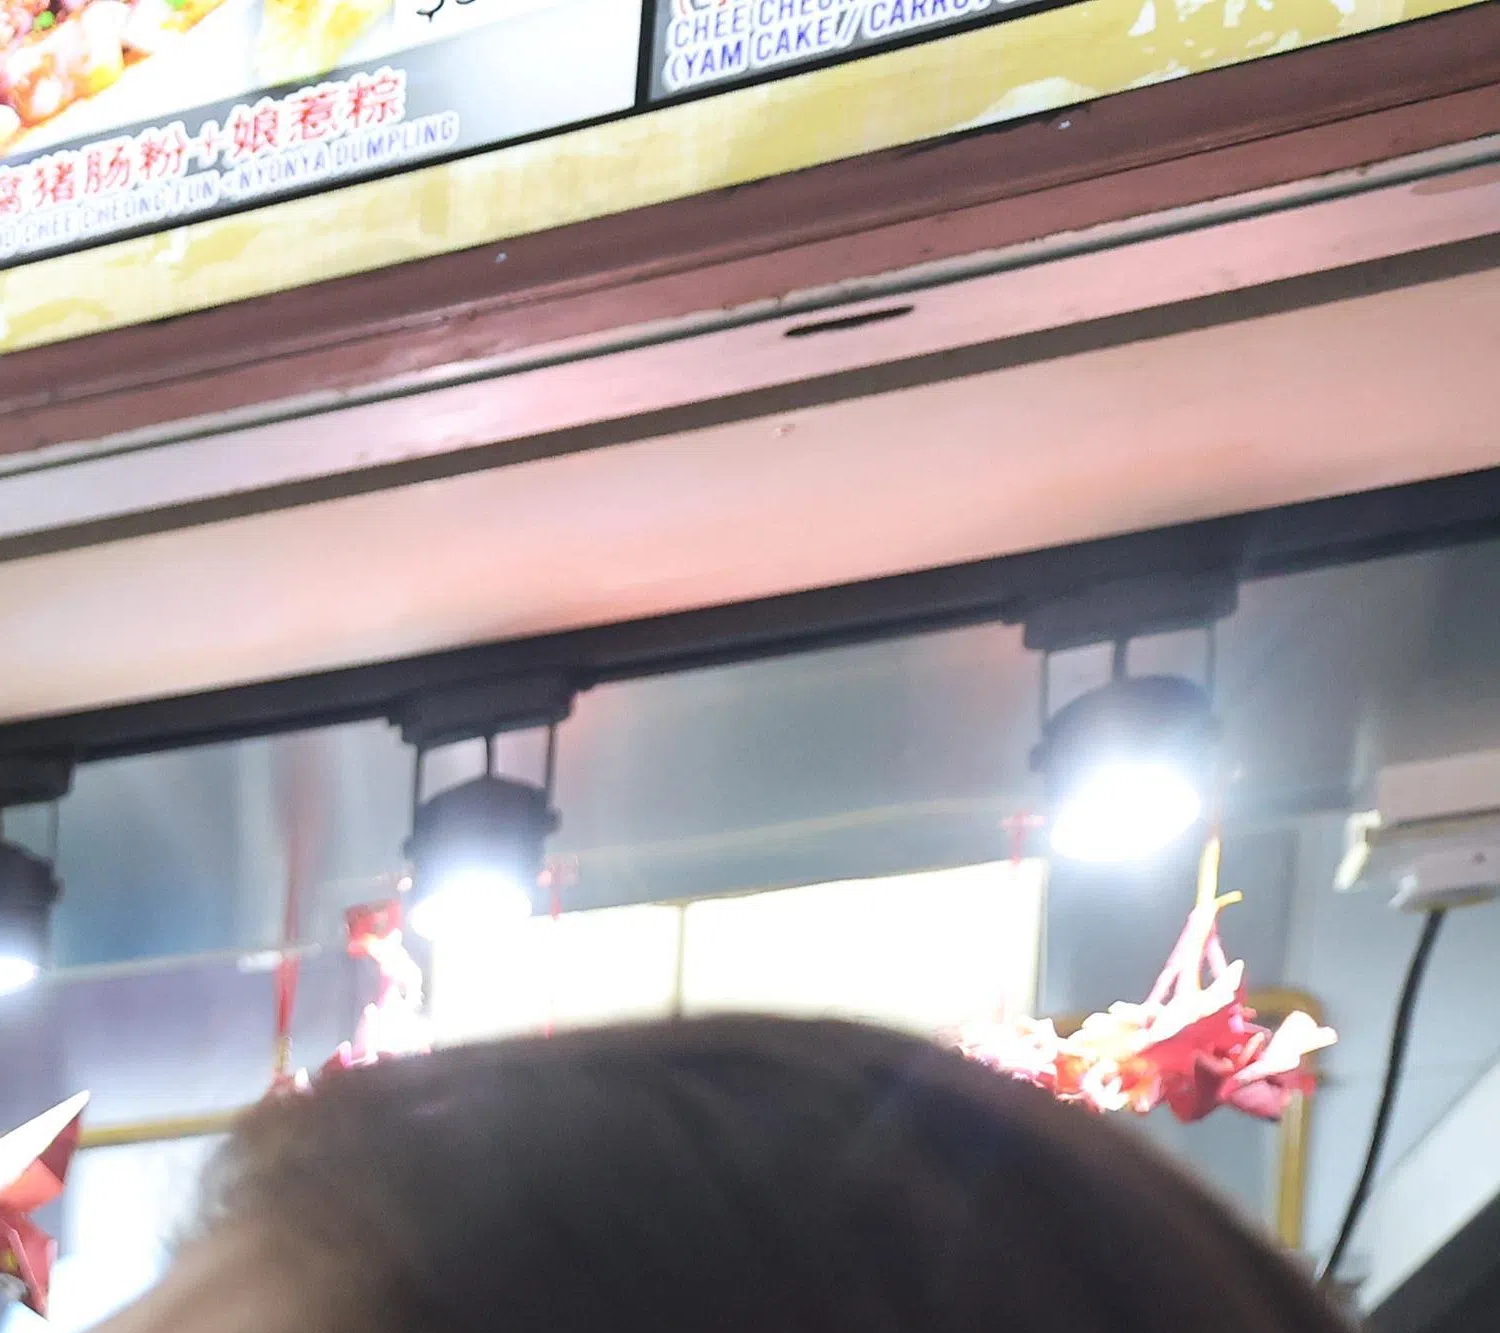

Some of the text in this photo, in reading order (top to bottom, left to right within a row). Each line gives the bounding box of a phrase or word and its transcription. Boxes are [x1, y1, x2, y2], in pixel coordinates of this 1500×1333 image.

[674, 4, 747, 48] CHEE
[671, 40, 743, 82] (YAM
[336, 117, 455, 167] DUMPLING
